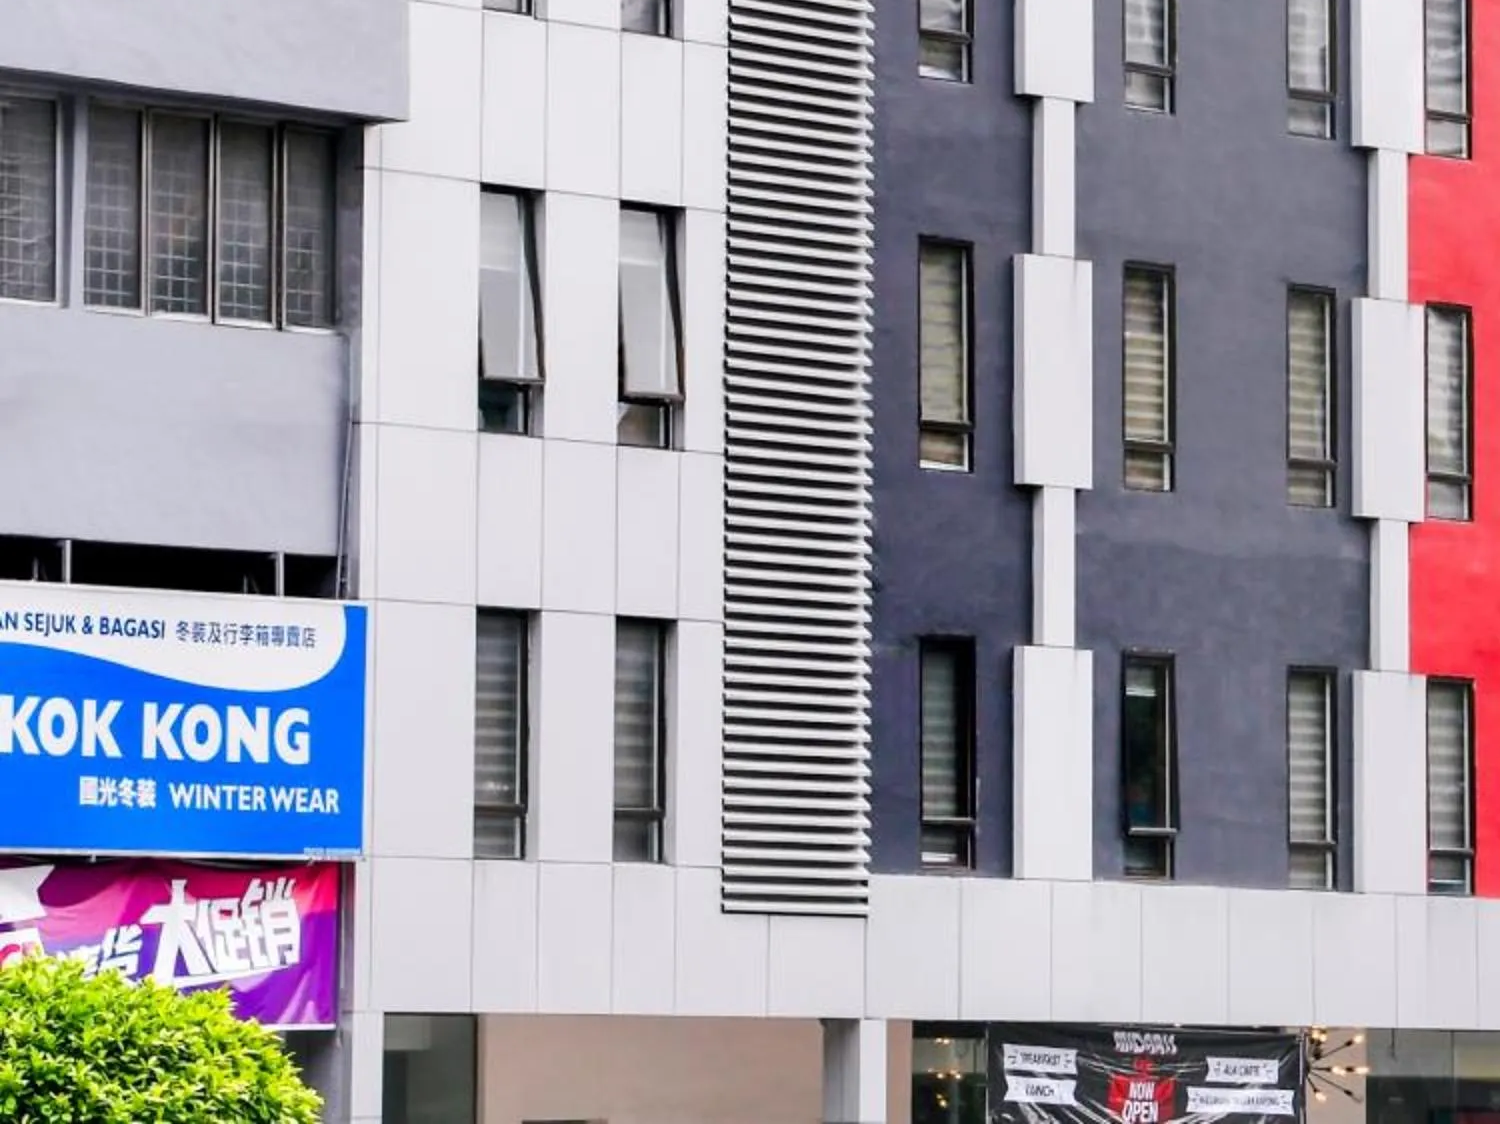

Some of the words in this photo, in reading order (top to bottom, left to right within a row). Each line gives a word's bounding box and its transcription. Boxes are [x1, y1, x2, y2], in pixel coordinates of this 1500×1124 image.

[23, 612, 76, 637] SEJUK
[81, 615, 94, 635] &
[99, 616, 166, 640] BAGASI
[0, 694, 124, 759] KOK
[141, 702, 311, 766] KONG
[168, 782, 267, 812] WINTER
[270, 787, 341, 815] WEAR
[1129, 1080, 1155, 1101] NOW
[1121, 1098, 1159, 1124] OPEN
